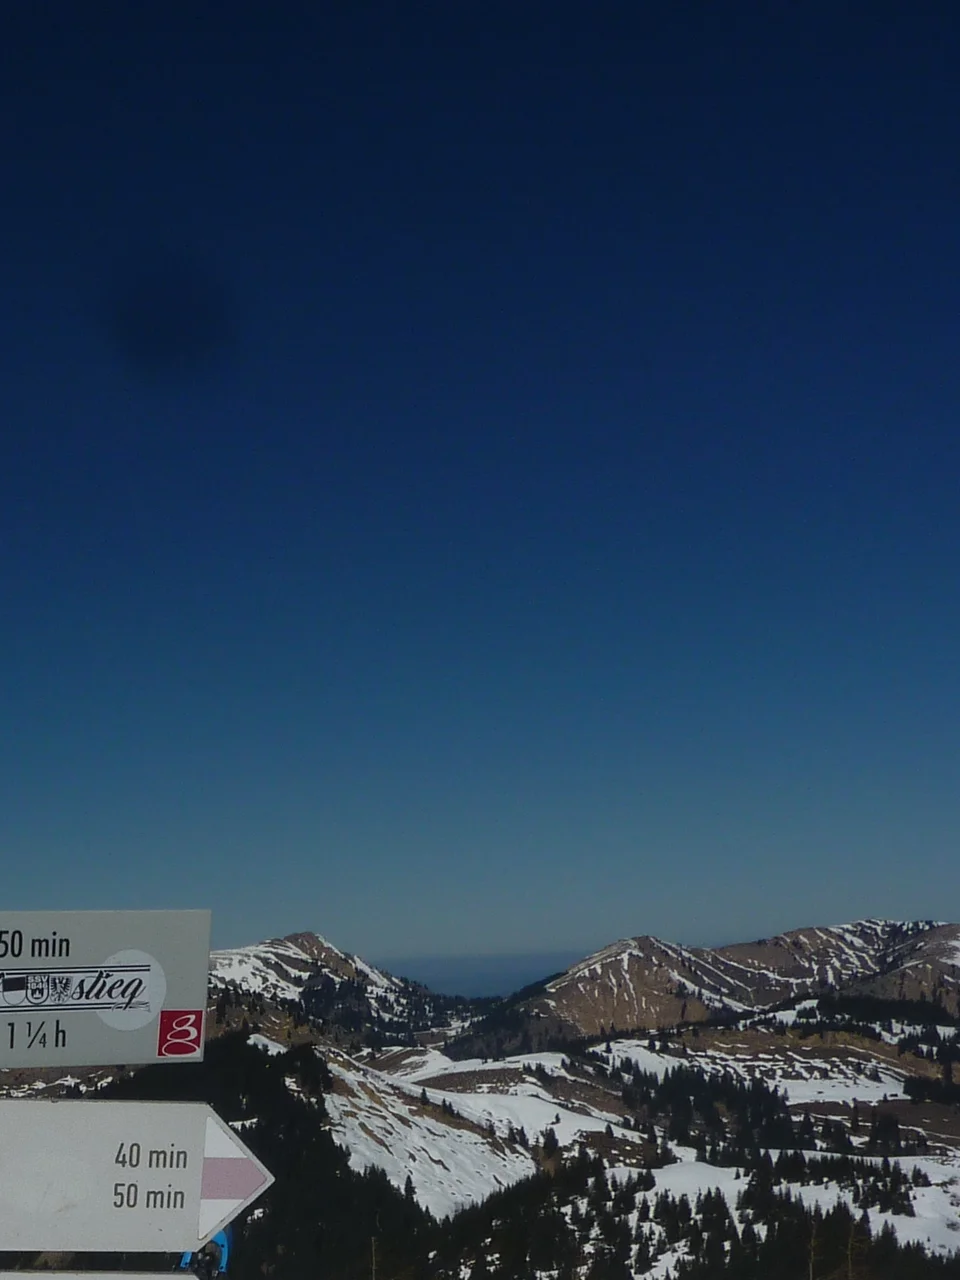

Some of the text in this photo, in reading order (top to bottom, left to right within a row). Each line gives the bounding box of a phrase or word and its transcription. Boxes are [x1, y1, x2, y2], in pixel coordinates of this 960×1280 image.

[30, 931, 71, 958] min
[54, 1019, 67, 1047] h
[114, 1142, 188, 1169] 40 min
[113, 1183, 185, 1209] 50 min
